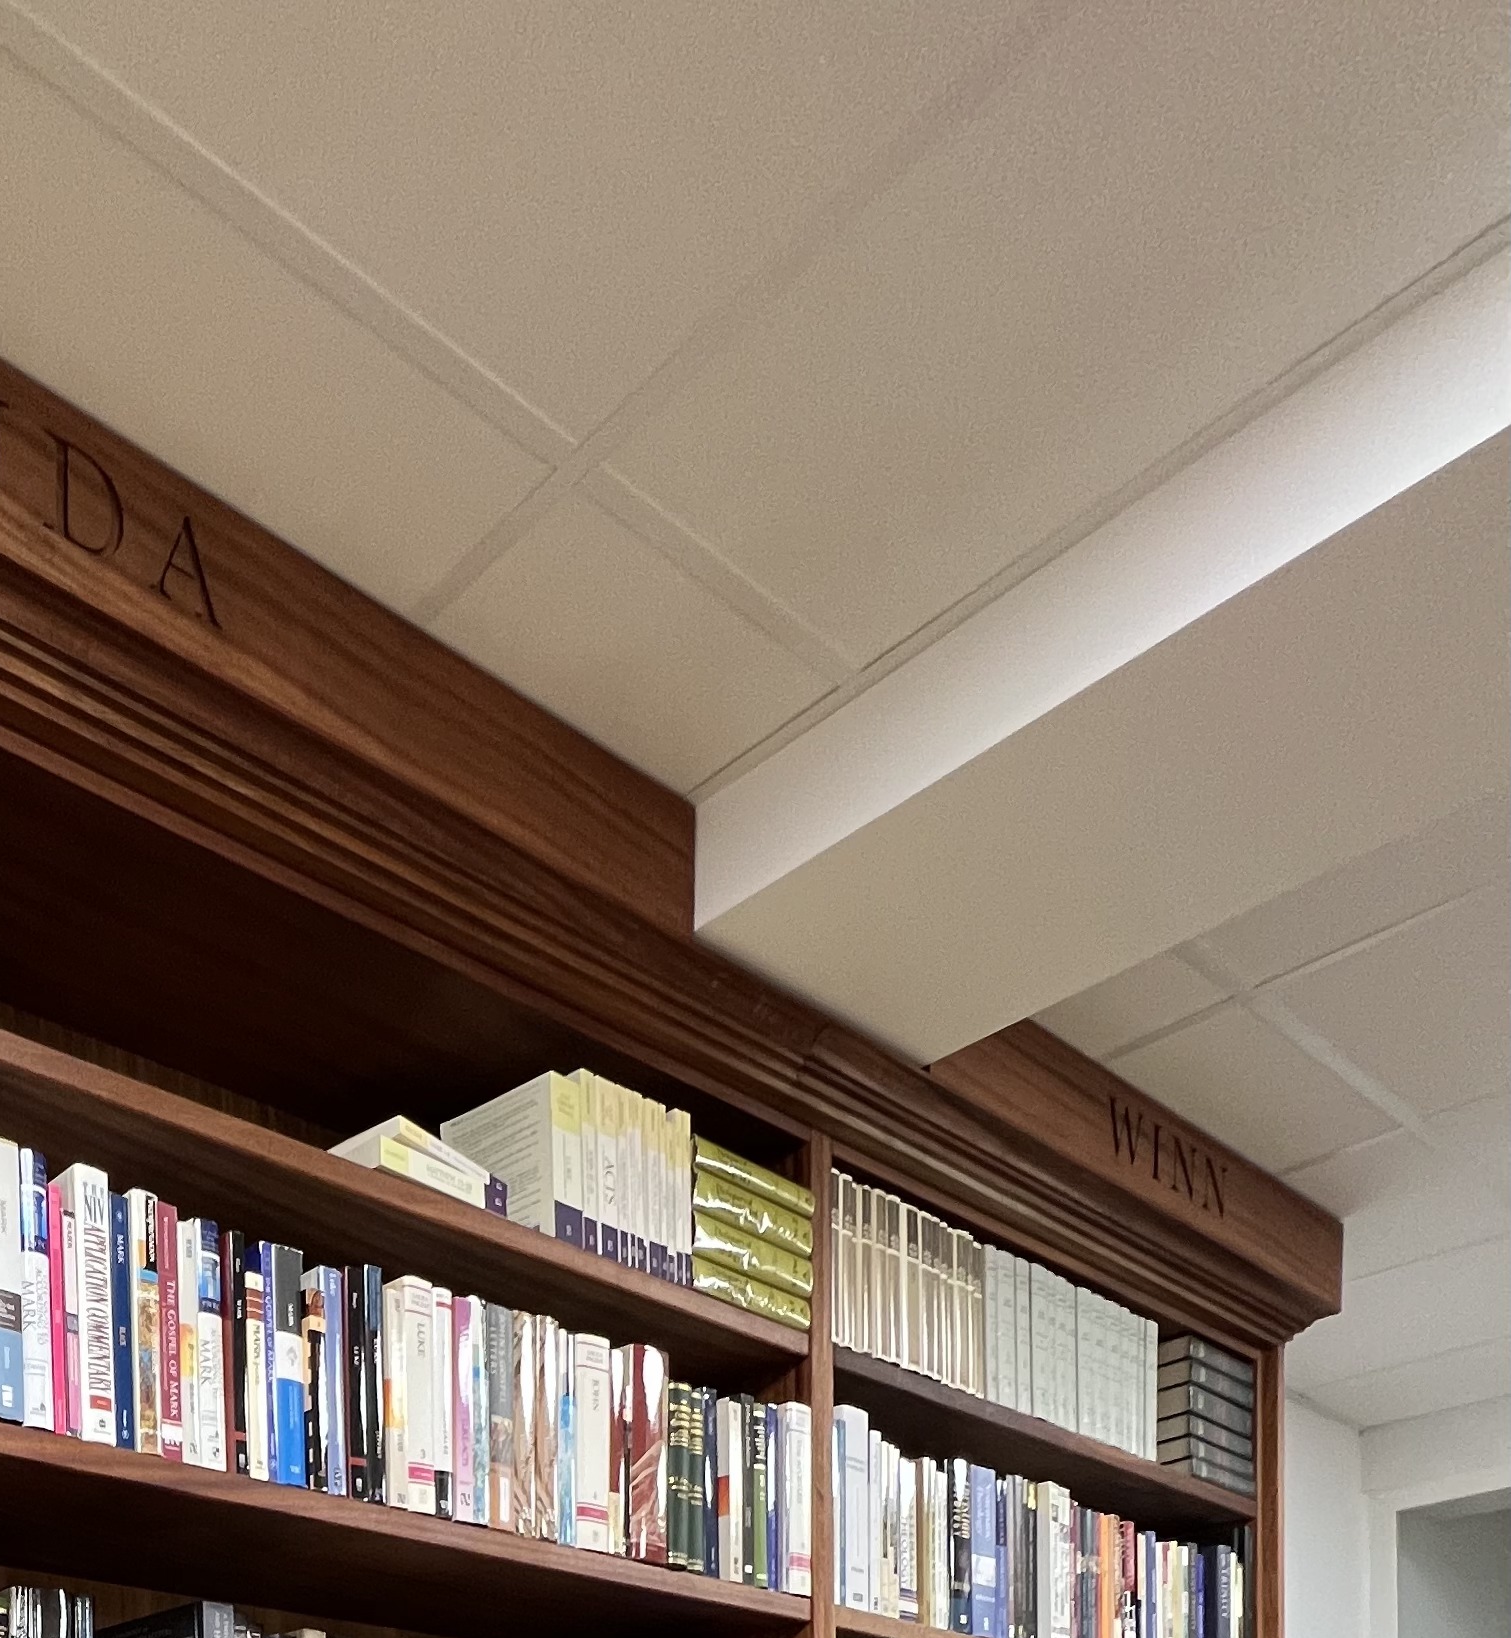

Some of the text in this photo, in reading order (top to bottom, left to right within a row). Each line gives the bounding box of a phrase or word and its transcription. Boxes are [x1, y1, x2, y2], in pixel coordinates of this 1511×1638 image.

[1110, 1095, 1228, 1219] WINN
[83, 1198, 104, 1224] NIV
[85, 1224, 108, 1307] APPLICATION
[22, 1280, 37, 1330] MARK
[87, 1307, 111, 1395] COMMENTARY
[200, 1339, 212, 1385] MARK
